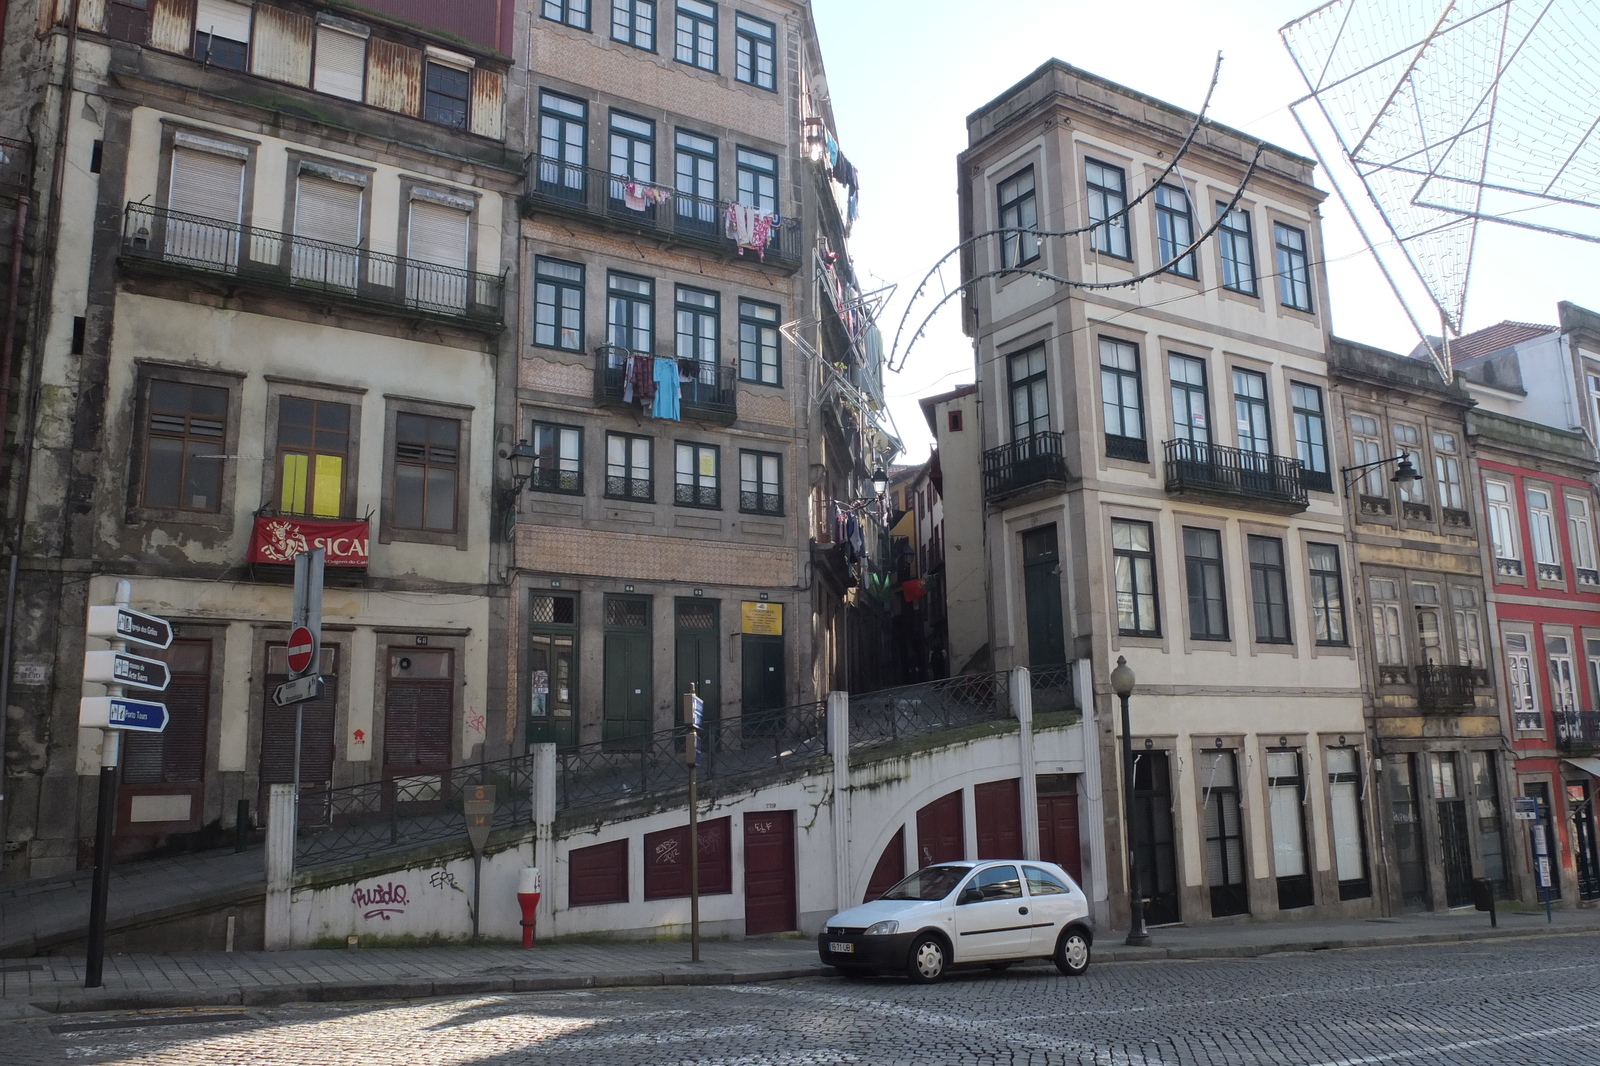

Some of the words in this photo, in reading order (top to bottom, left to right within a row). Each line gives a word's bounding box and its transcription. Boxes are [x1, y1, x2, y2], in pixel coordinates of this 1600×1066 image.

[417, 636, 427, 644] 68
[128, 671, 138, 680] Arte
[137, 672, 148, 682] Sacra
[125, 709, 136, 719] Porto
[137, 711, 148, 720] Tours
